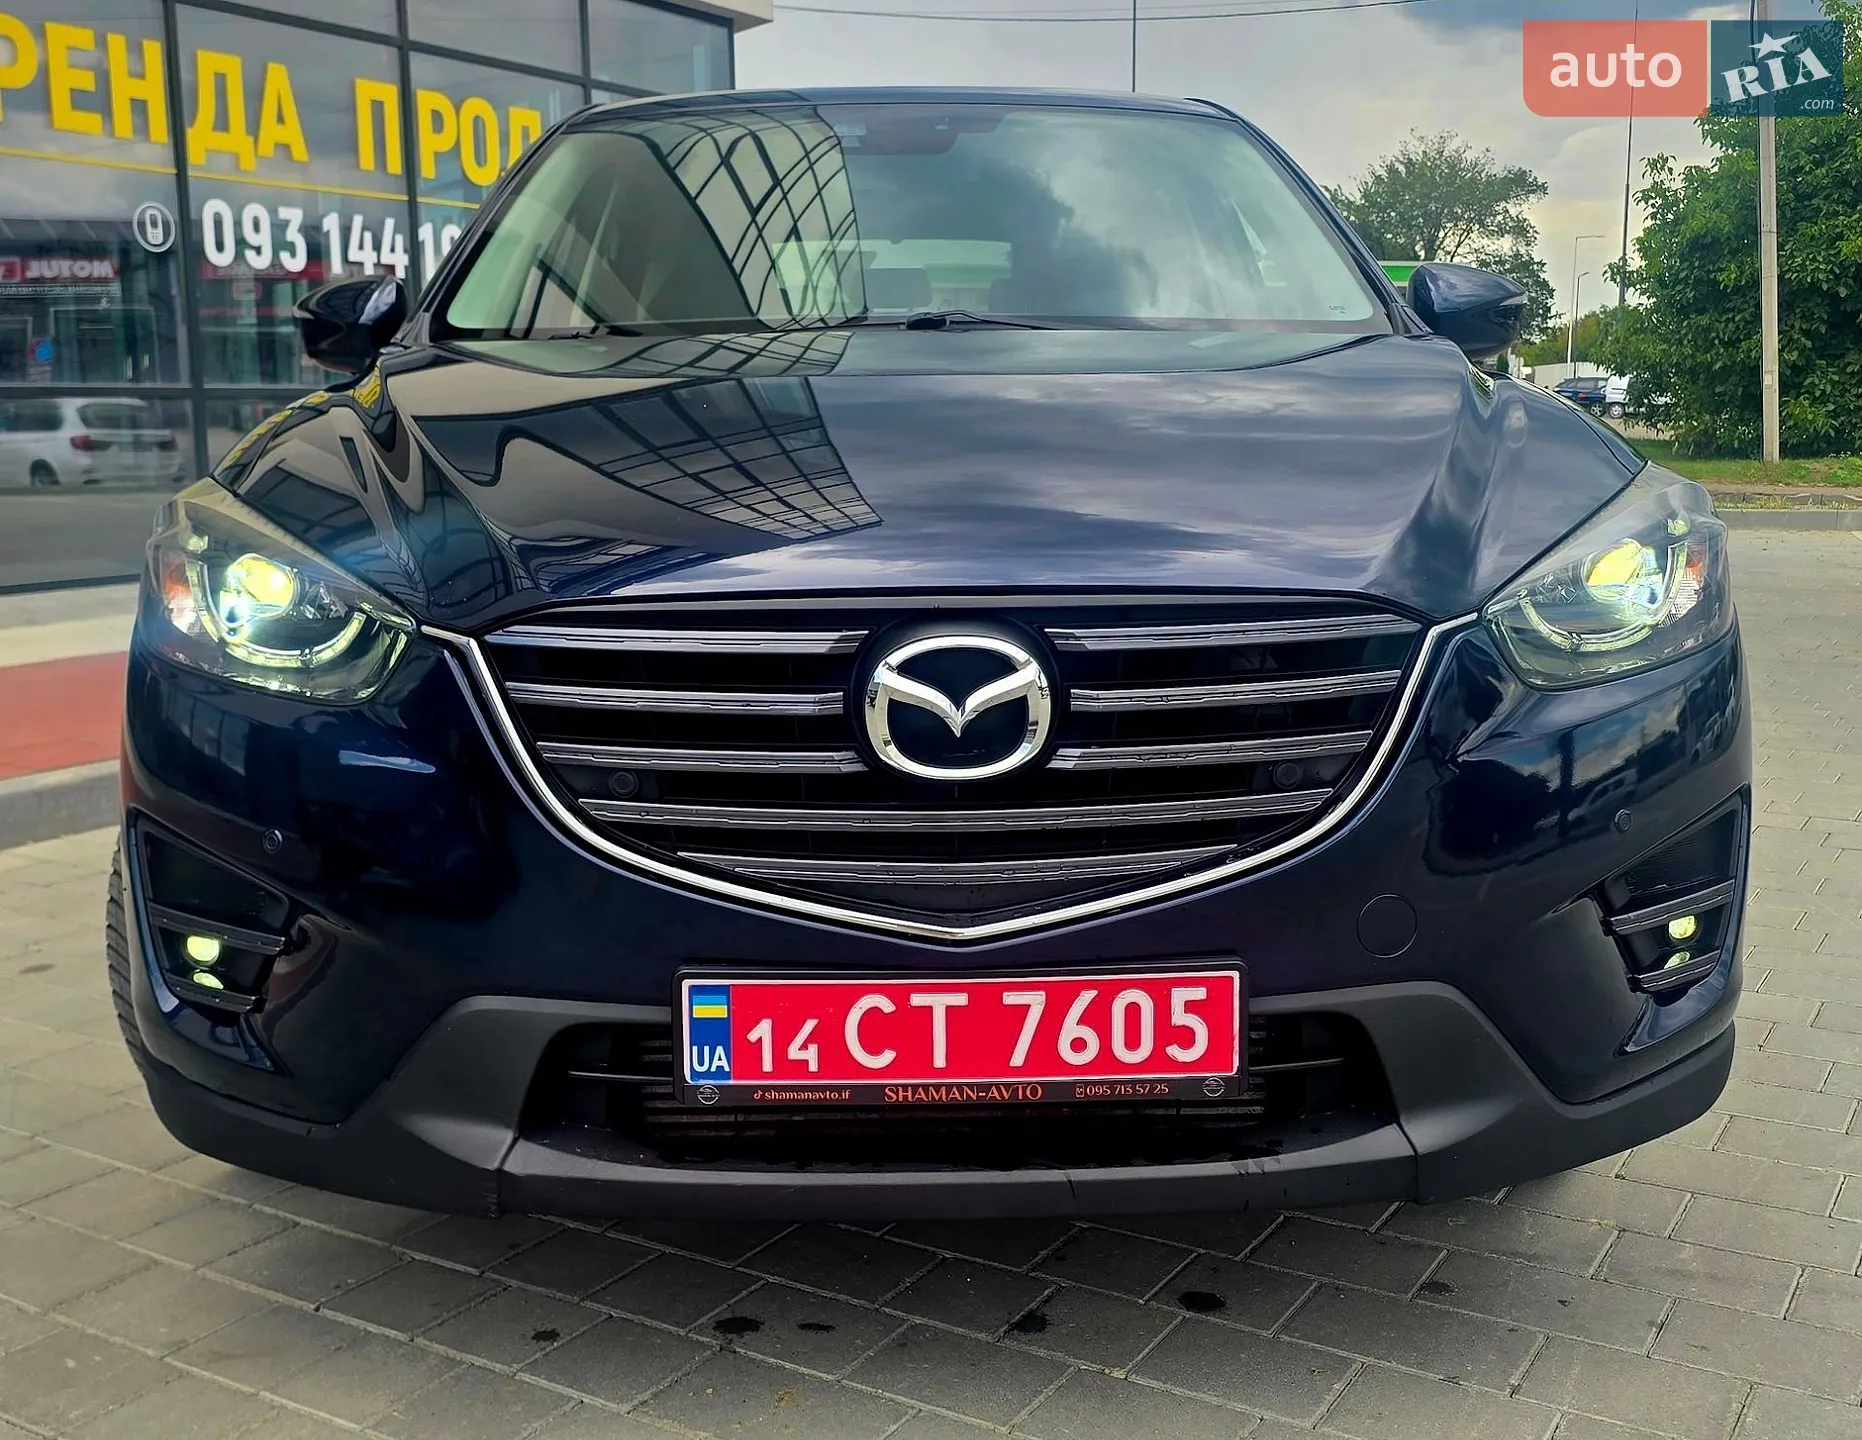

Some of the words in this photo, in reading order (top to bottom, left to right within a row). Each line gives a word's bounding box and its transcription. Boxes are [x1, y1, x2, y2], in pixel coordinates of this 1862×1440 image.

[202, 198, 308, 273] 093
[322, 212, 409, 279] 144
[746, 1018, 818, 1072] 14
[844, 993, 968, 1070] CT
[1002, 986, 1209, 1068] 7605
[692, 1045, 730, 1073] UA
[764, 1089, 852, 1101] shamanavto.if
[884, 1083, 1043, 1103] SHAMAN-AVTO
[1086, 1085, 1111, 1096] 095
[1114, 1084, 1133, 1096] 713
[1135, 1083, 1150, 1095] 57
[1153, 1083, 1169, 1094] 25
